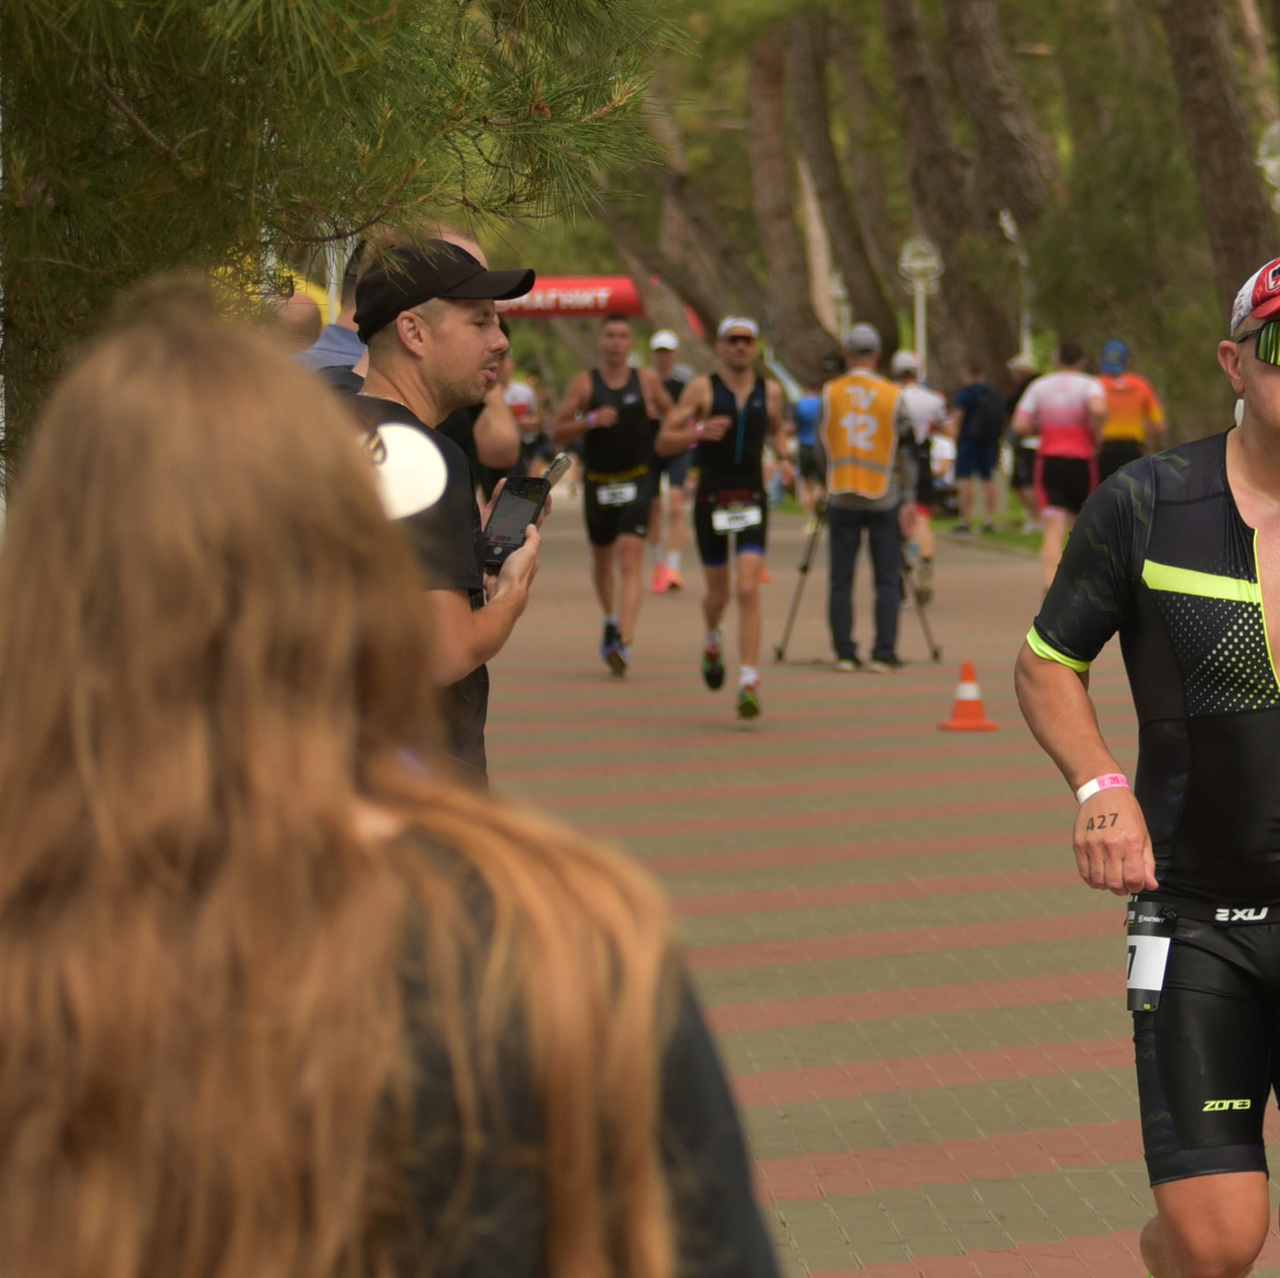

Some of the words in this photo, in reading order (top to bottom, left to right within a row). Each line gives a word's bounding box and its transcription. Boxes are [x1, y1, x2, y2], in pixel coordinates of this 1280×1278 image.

[845, 386, 877, 410] TV
[840, 411, 878, 450] 12
[1086, 812, 1119, 831] 427
[1214, 907, 1269, 921] 2XU
[1202, 1098, 1251, 1112] ZONE3
